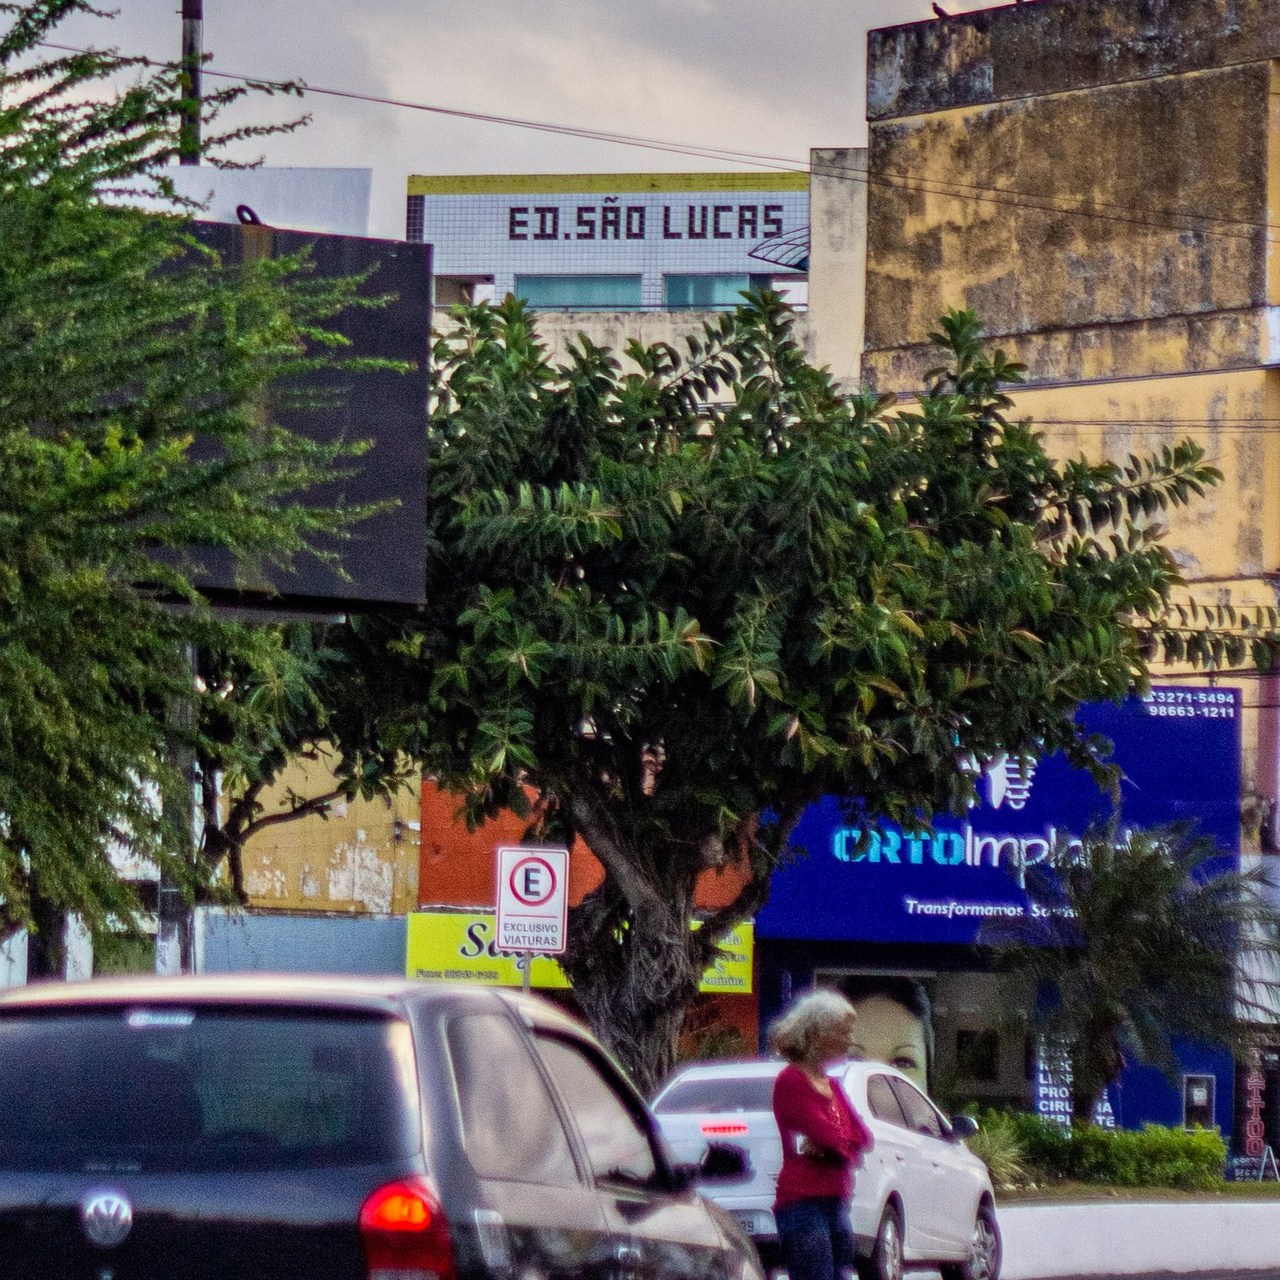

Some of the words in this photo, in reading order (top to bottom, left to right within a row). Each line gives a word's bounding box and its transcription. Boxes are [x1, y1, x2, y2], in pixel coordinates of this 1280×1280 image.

[663, 204, 784, 240] LUCAS
[1157, 692, 1235, 704] 3271-5494
[1149, 705, 1235, 718] 98663-1211
[524, 868, 541, 896] E
[906, 900, 1024, 919] Transformamos
[503, 923, 559, 934] EXCLUSIVO
[503, 936, 558, 947] VIATURAS
